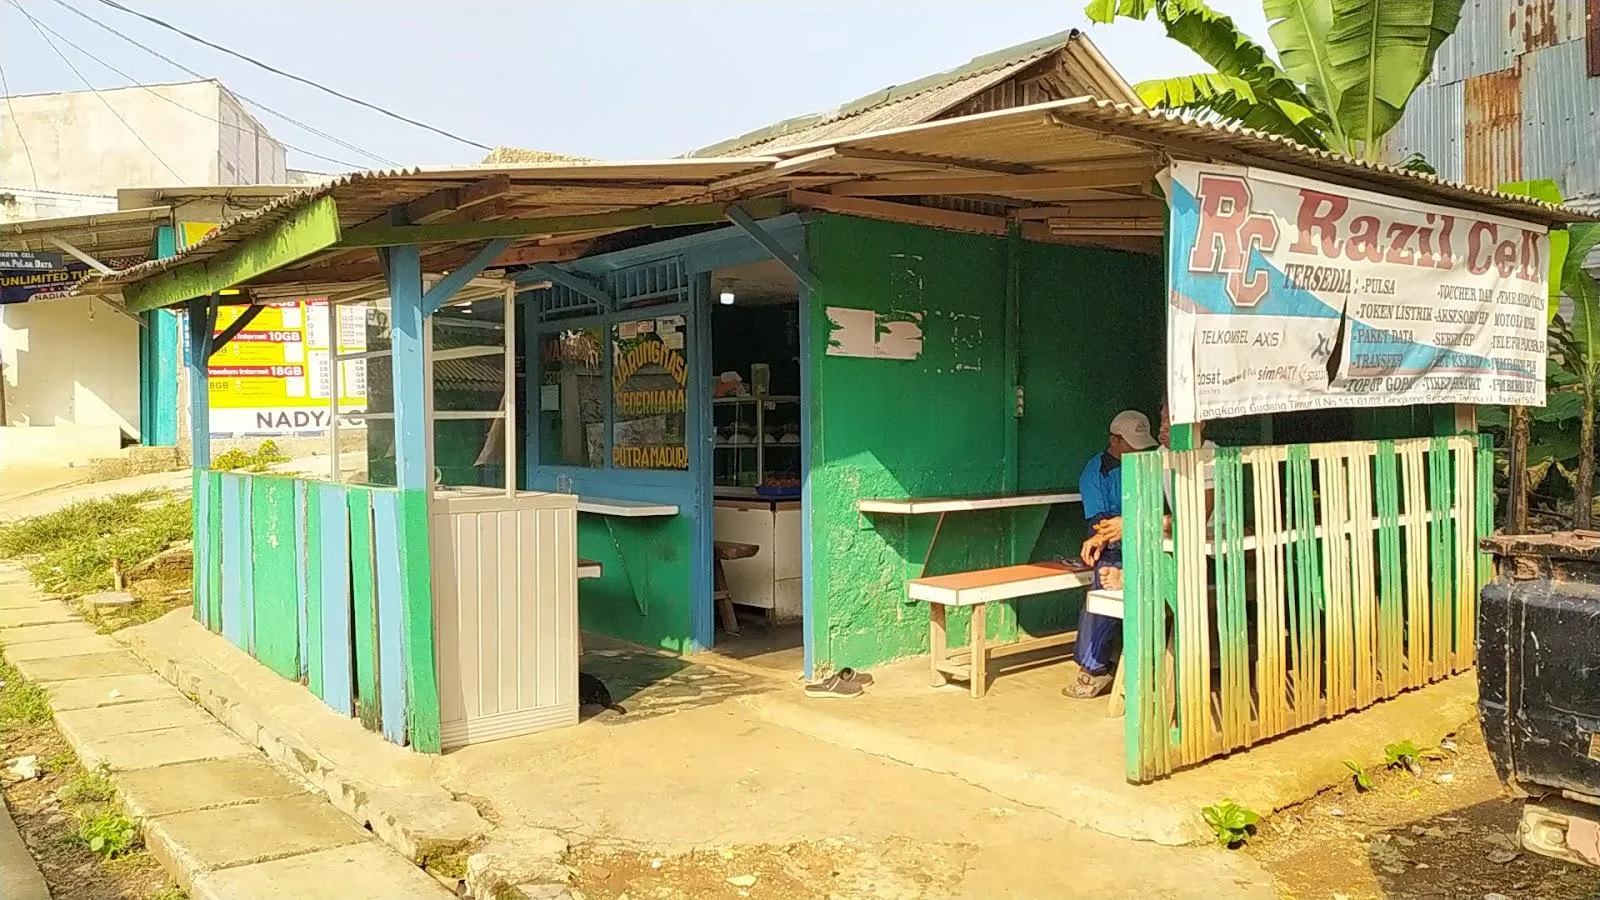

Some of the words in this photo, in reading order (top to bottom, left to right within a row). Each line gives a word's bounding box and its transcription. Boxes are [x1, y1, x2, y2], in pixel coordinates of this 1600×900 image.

[1289, 188, 1455, 270] Razil
[1466, 221, 1541, 284] Cell
[1, 272, 69, 287] UNLIMITED
[1363, 278, 1396, 295] PULSA
[35, 292, 66, 301] NADIA
[1359, 303, 1394, 320] TOKEN
[1395, 305, 1433, 321] LISTRIK
[268, 331, 301, 342] 10GB
[1357, 328, 1390, 344] PAKET
[1391, 329, 1414, 344] DATA
[239, 367, 269, 376] Internet
[270, 366, 303, 377] 18GB
[612, 446, 649, 468] PUTRA
